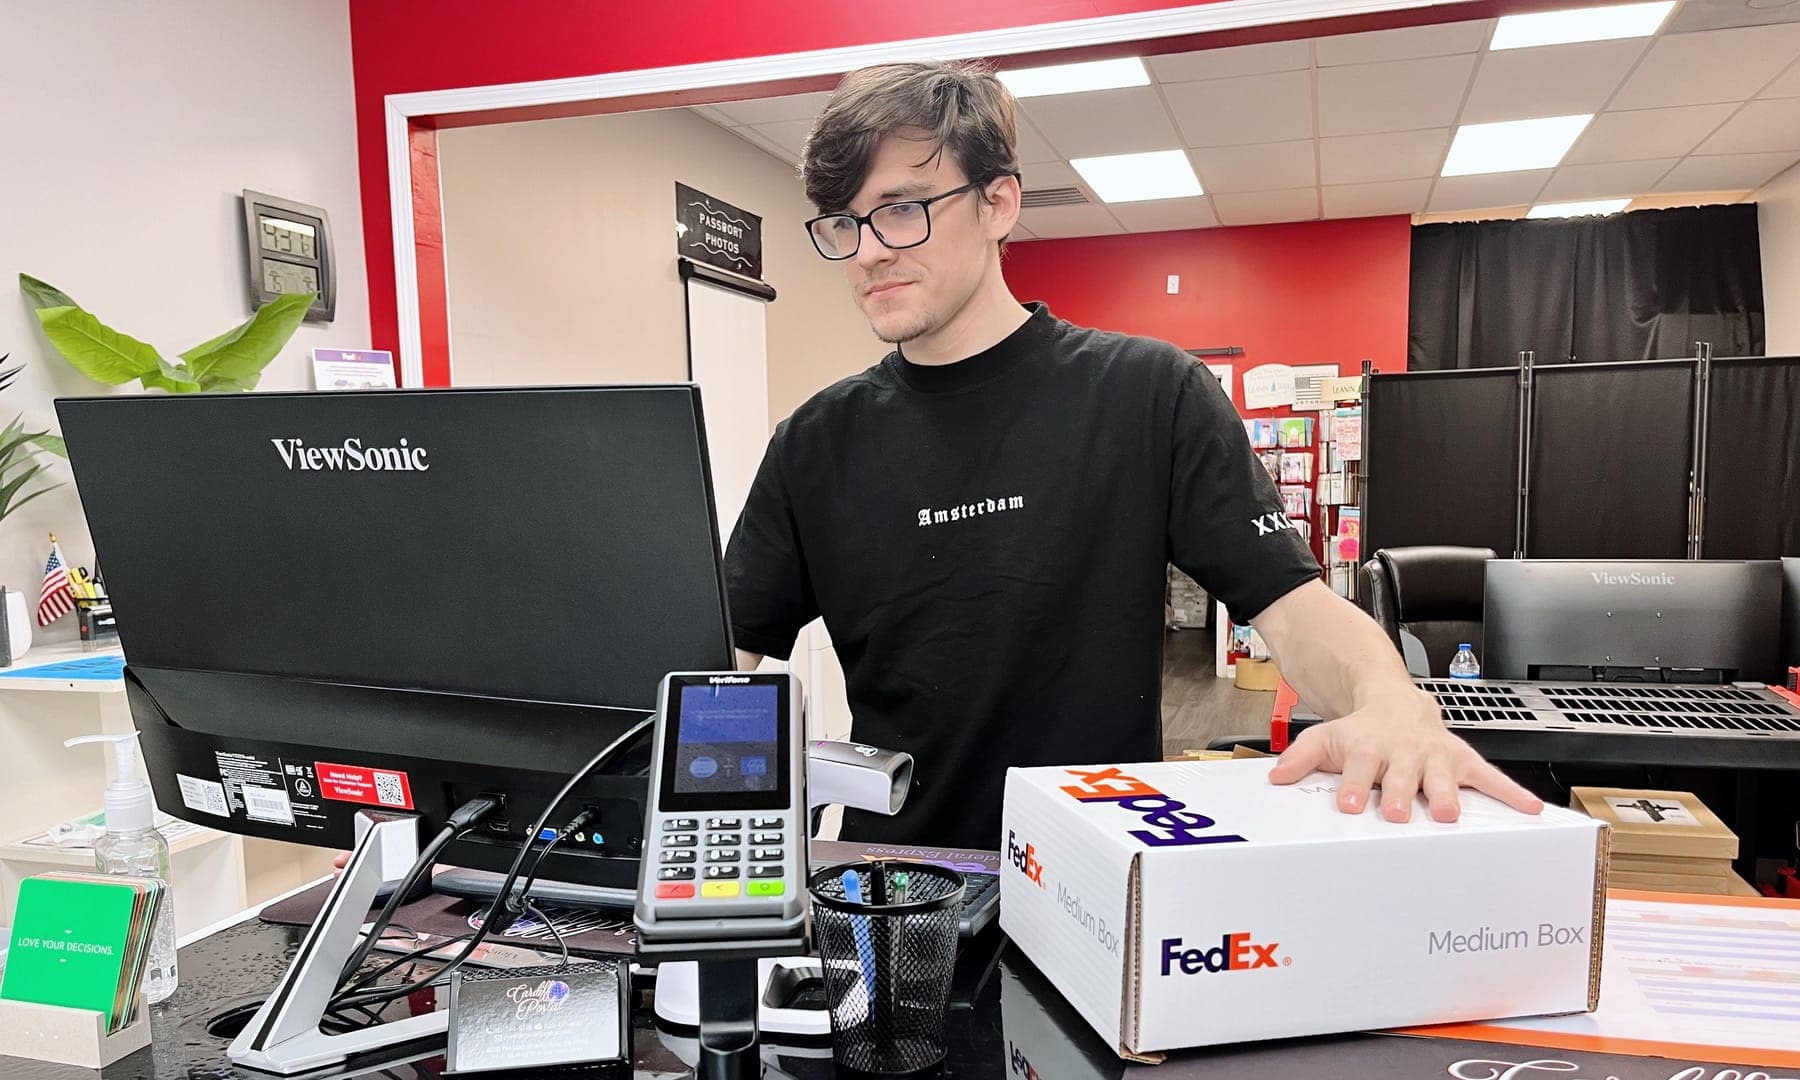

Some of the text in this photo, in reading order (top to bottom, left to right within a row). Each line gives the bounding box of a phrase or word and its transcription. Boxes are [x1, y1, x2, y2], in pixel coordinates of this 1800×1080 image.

[699, 212, 743, 239] PASSPORT
[705, 233, 740, 254] PHOTOS
[271, 438, 430, 472] ViewSonic
[918, 496, 1024, 527] Amsterdam
[1591, 572, 1676, 586] ViewSonic
[1058, 767, 1249, 847] FedEx
[1008, 829, 1044, 888] FedEx
[1057, 881, 1119, 957] Medium Box
[18, 937, 114, 955] LOVE YOUR DECISIONS.
[1161, 932, 1280, 976] FedEx
[1428, 923, 1585, 955] Medium Box
